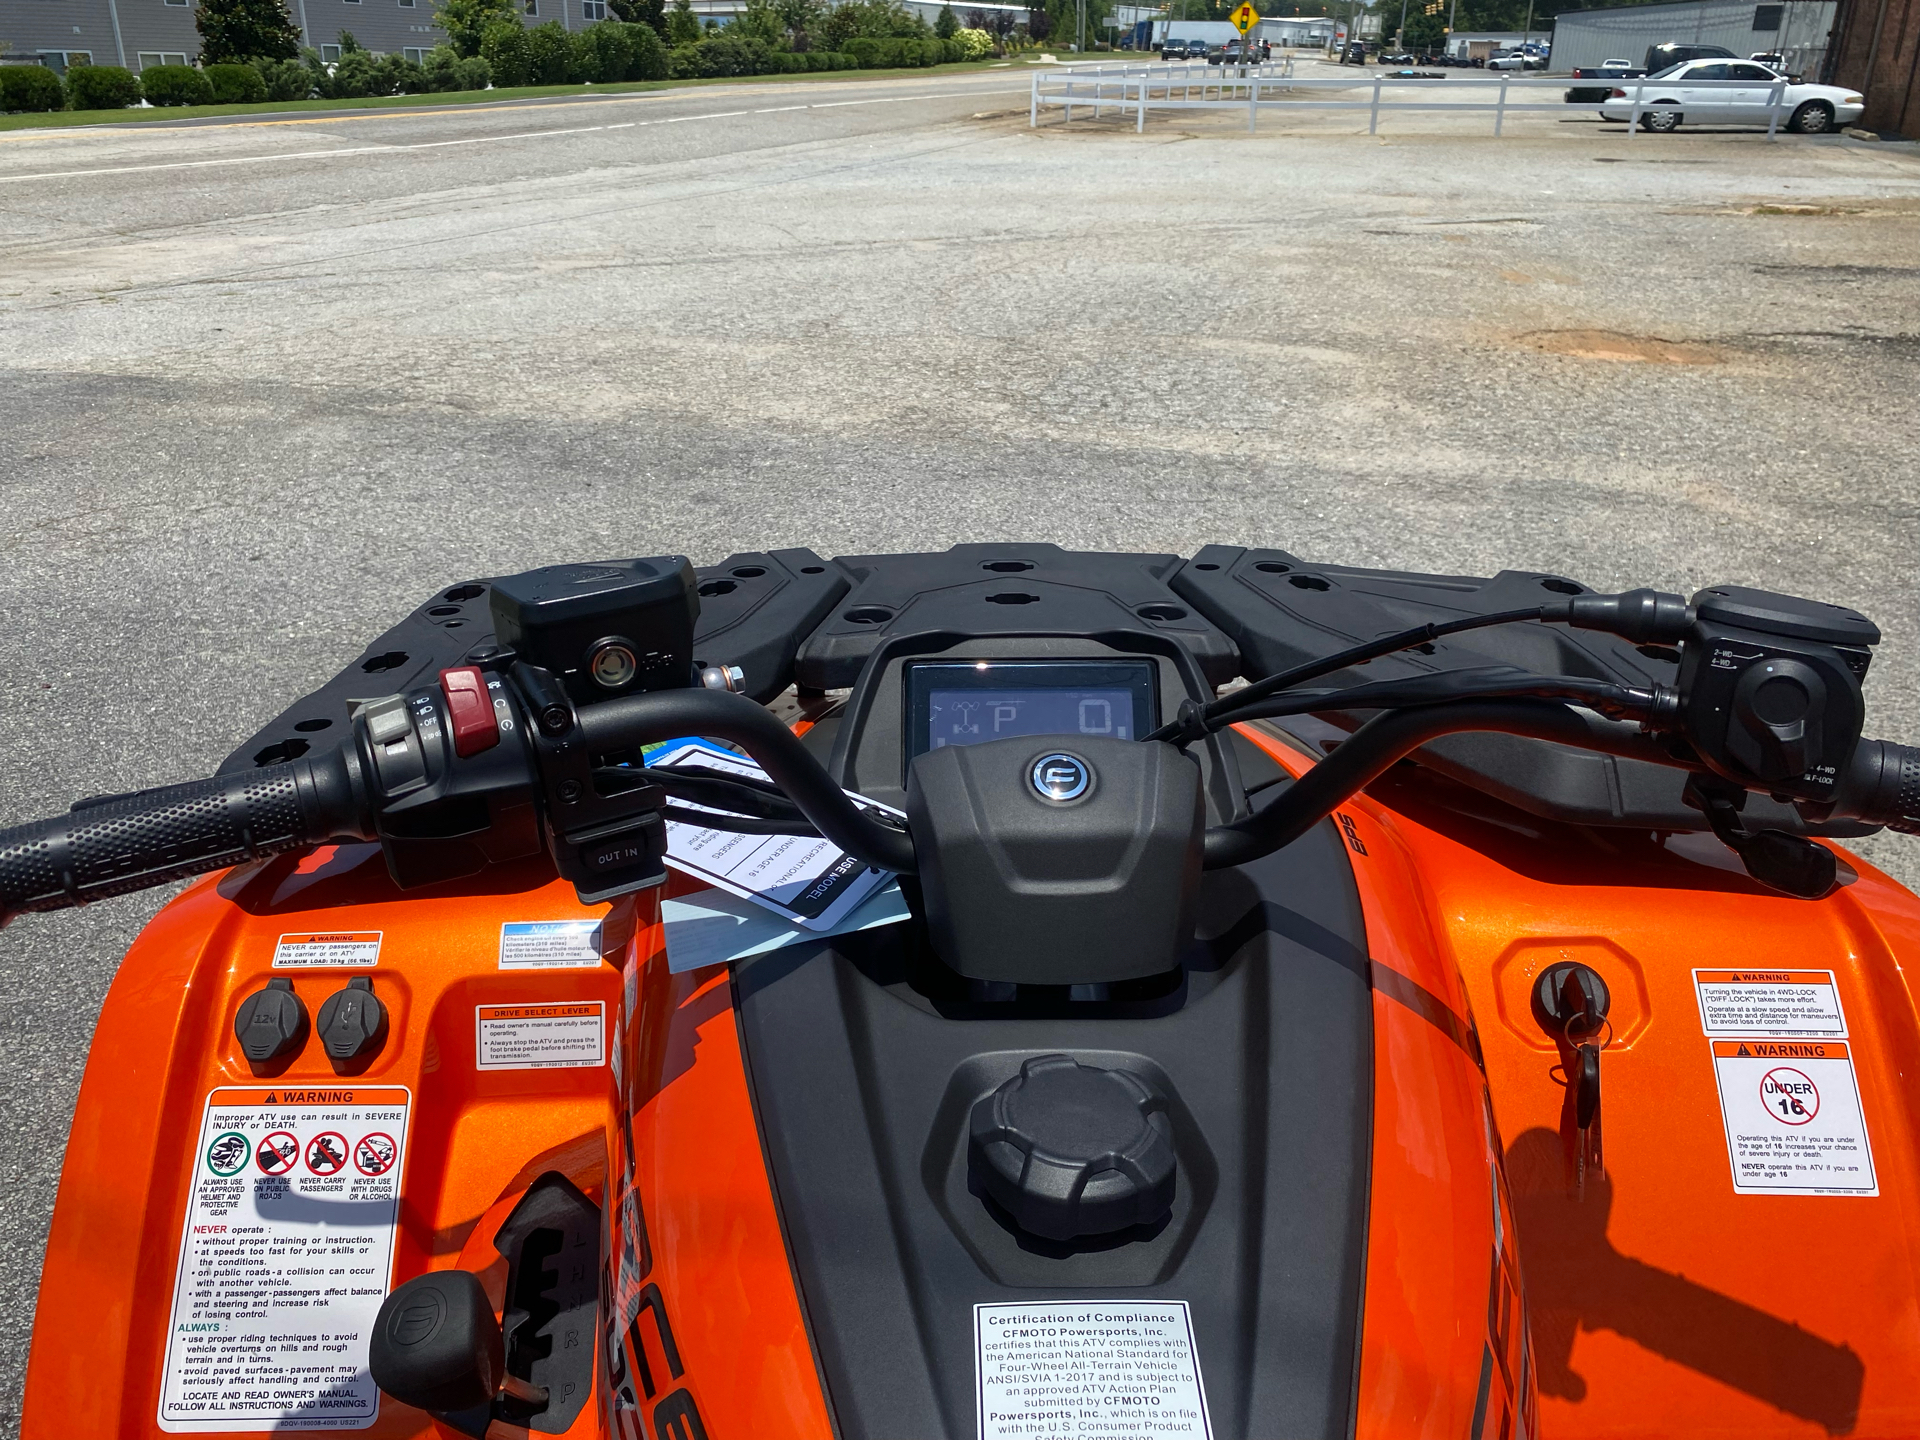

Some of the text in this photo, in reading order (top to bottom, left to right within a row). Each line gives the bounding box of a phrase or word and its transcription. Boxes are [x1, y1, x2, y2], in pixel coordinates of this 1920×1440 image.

[1714, 649, 1732, 657] 2-WD
[1712, 658, 1730, 666] 4-WD
[424, 717, 437, 726] OFF
[994, 706, 1016, 732] P
[598, 848, 638, 864] OUT IN
[748, 836, 797, 877] UNDER AGE 16
[775, 841, 828, 888] RECREATIONAL
[806, 856, 858, 900] USE MODEL
[525, 1008, 558, 1016] SELECT
[1754, 1045, 1825, 1056] WARNING
[1765, 1083, 1813, 1095] UNDER
[284, 1092, 353, 1102] WARNING
[1778, 1099, 1805, 1115] 16
[214, 1113, 254, 1121] Improper
[258, 1113, 276, 1121] ATV
[365, 1112, 402, 1121] SEVERE
[213, 1120, 246, 1129] INJURY
[264, 1121, 297, 1129] DEATH.
[194, 1225, 264, 1235] NEVER operate
[203, 1237, 235, 1245] without
[274, 1237, 307, 1246] training
[326, 1236, 375, 1244] instruction.
[200, 1258, 266, 1266] the conditions.
[572, 1264, 585, 1282] H
[197, 1278, 292, 1287] with another vehicle.
[205, 1311, 231, 1321] losing
[235, 1310, 268, 1318] control.
[989, 1313, 1174, 1325] Certification of Compliance
[178, 1323, 219, 1332] ALWAYS
[1003, 1328, 1166, 1338] CFMOTO Powersports, Inc.
[564, 1329, 578, 1348] R
[985, 1338, 1186, 1350] certifies that this ATV complies with
[986, 1349, 1188, 1361] the American National Standard for
[1000, 1361, 1177, 1372] Four-Wheel All-Terrain Vehicle
[987, 1373, 1192, 1385] ANSI/SVIA 1-2017 and is subject to
[183, 1392, 218, 1400] LOCATE
[245, 1391, 269, 1399] READ
[274, 1390, 314, 1399] OWNER'S
[319, 1390, 357, 1398] MANUAL.
[561, 1381, 576, 1403] P
[1024, 1385, 1079, 1397] approved
[1082, 1384, 1106, 1393] ATV
[1109, 1384, 1146, 1393] Action
[1150, 1384, 1176, 1393] Plan
[168, 1400, 368, 1411] FOLLOW ALL INSTRUCTIONS AND WARNINGS.
[1024, 1396, 1160, 1407] submitted by CFMOTO
